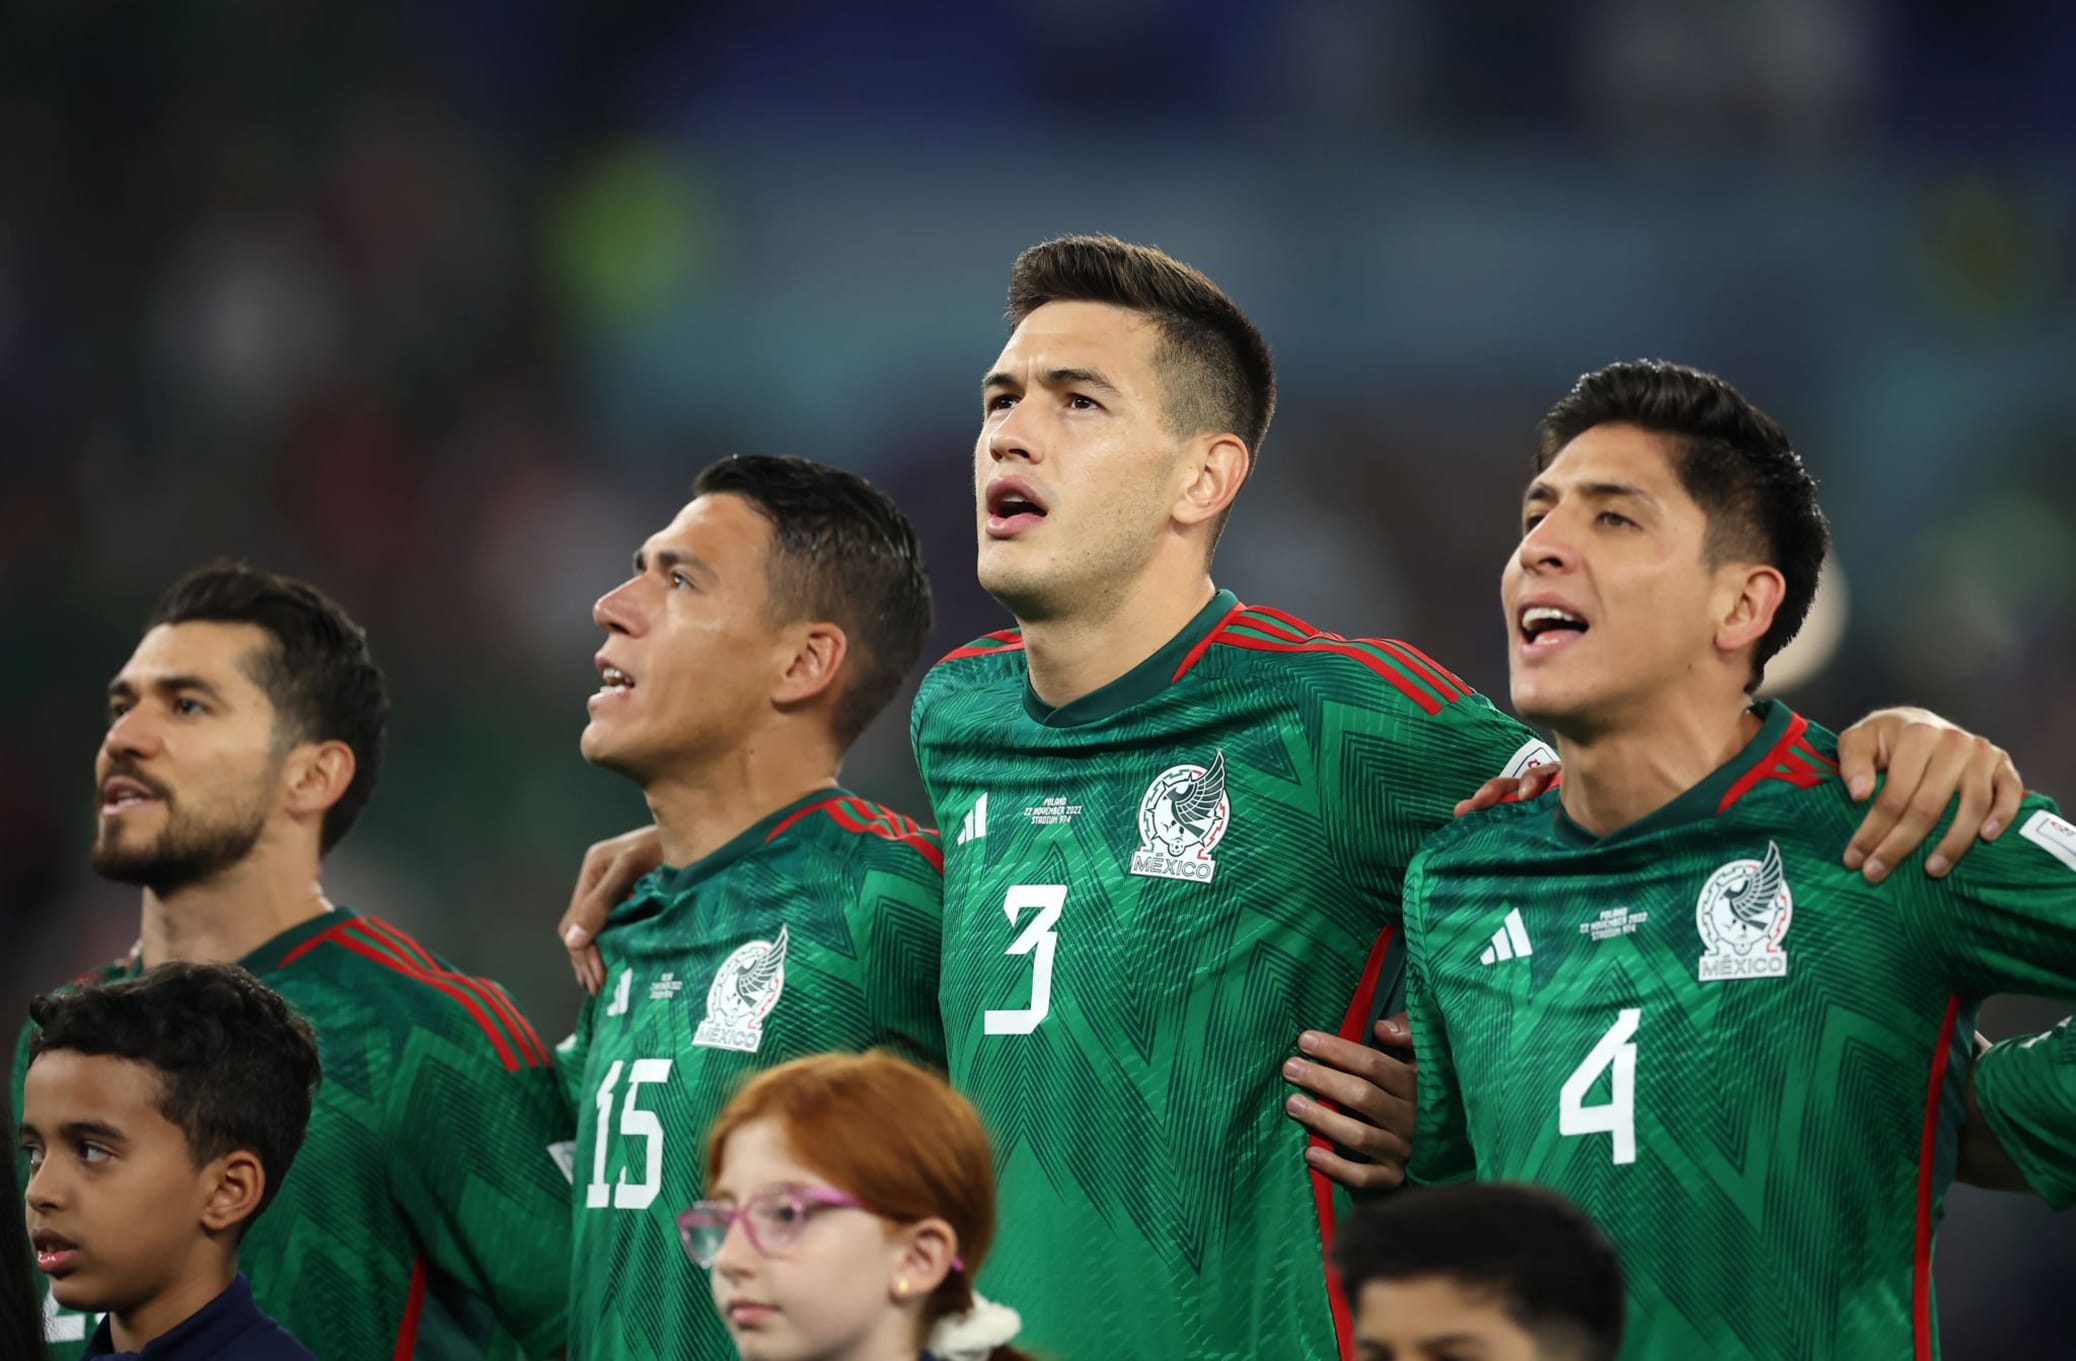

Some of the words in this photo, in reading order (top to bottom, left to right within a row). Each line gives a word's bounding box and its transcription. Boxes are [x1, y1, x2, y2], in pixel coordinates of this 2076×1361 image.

[1033, 806, 1065, 815] NOVEMBER
[1043, 797, 1067, 806] POLAND
[1031, 815, 1057, 825] STADIUM
[1133, 852, 1211, 879] MÉXICO
[984, 884, 1068, 1035] 3
[1702, 954, 1783, 977] MÉXICO
[697, 1023, 758, 1048] MÉXICO
[1559, 1008, 1641, 1165] 4
[586, 1059, 673, 1209] 15
